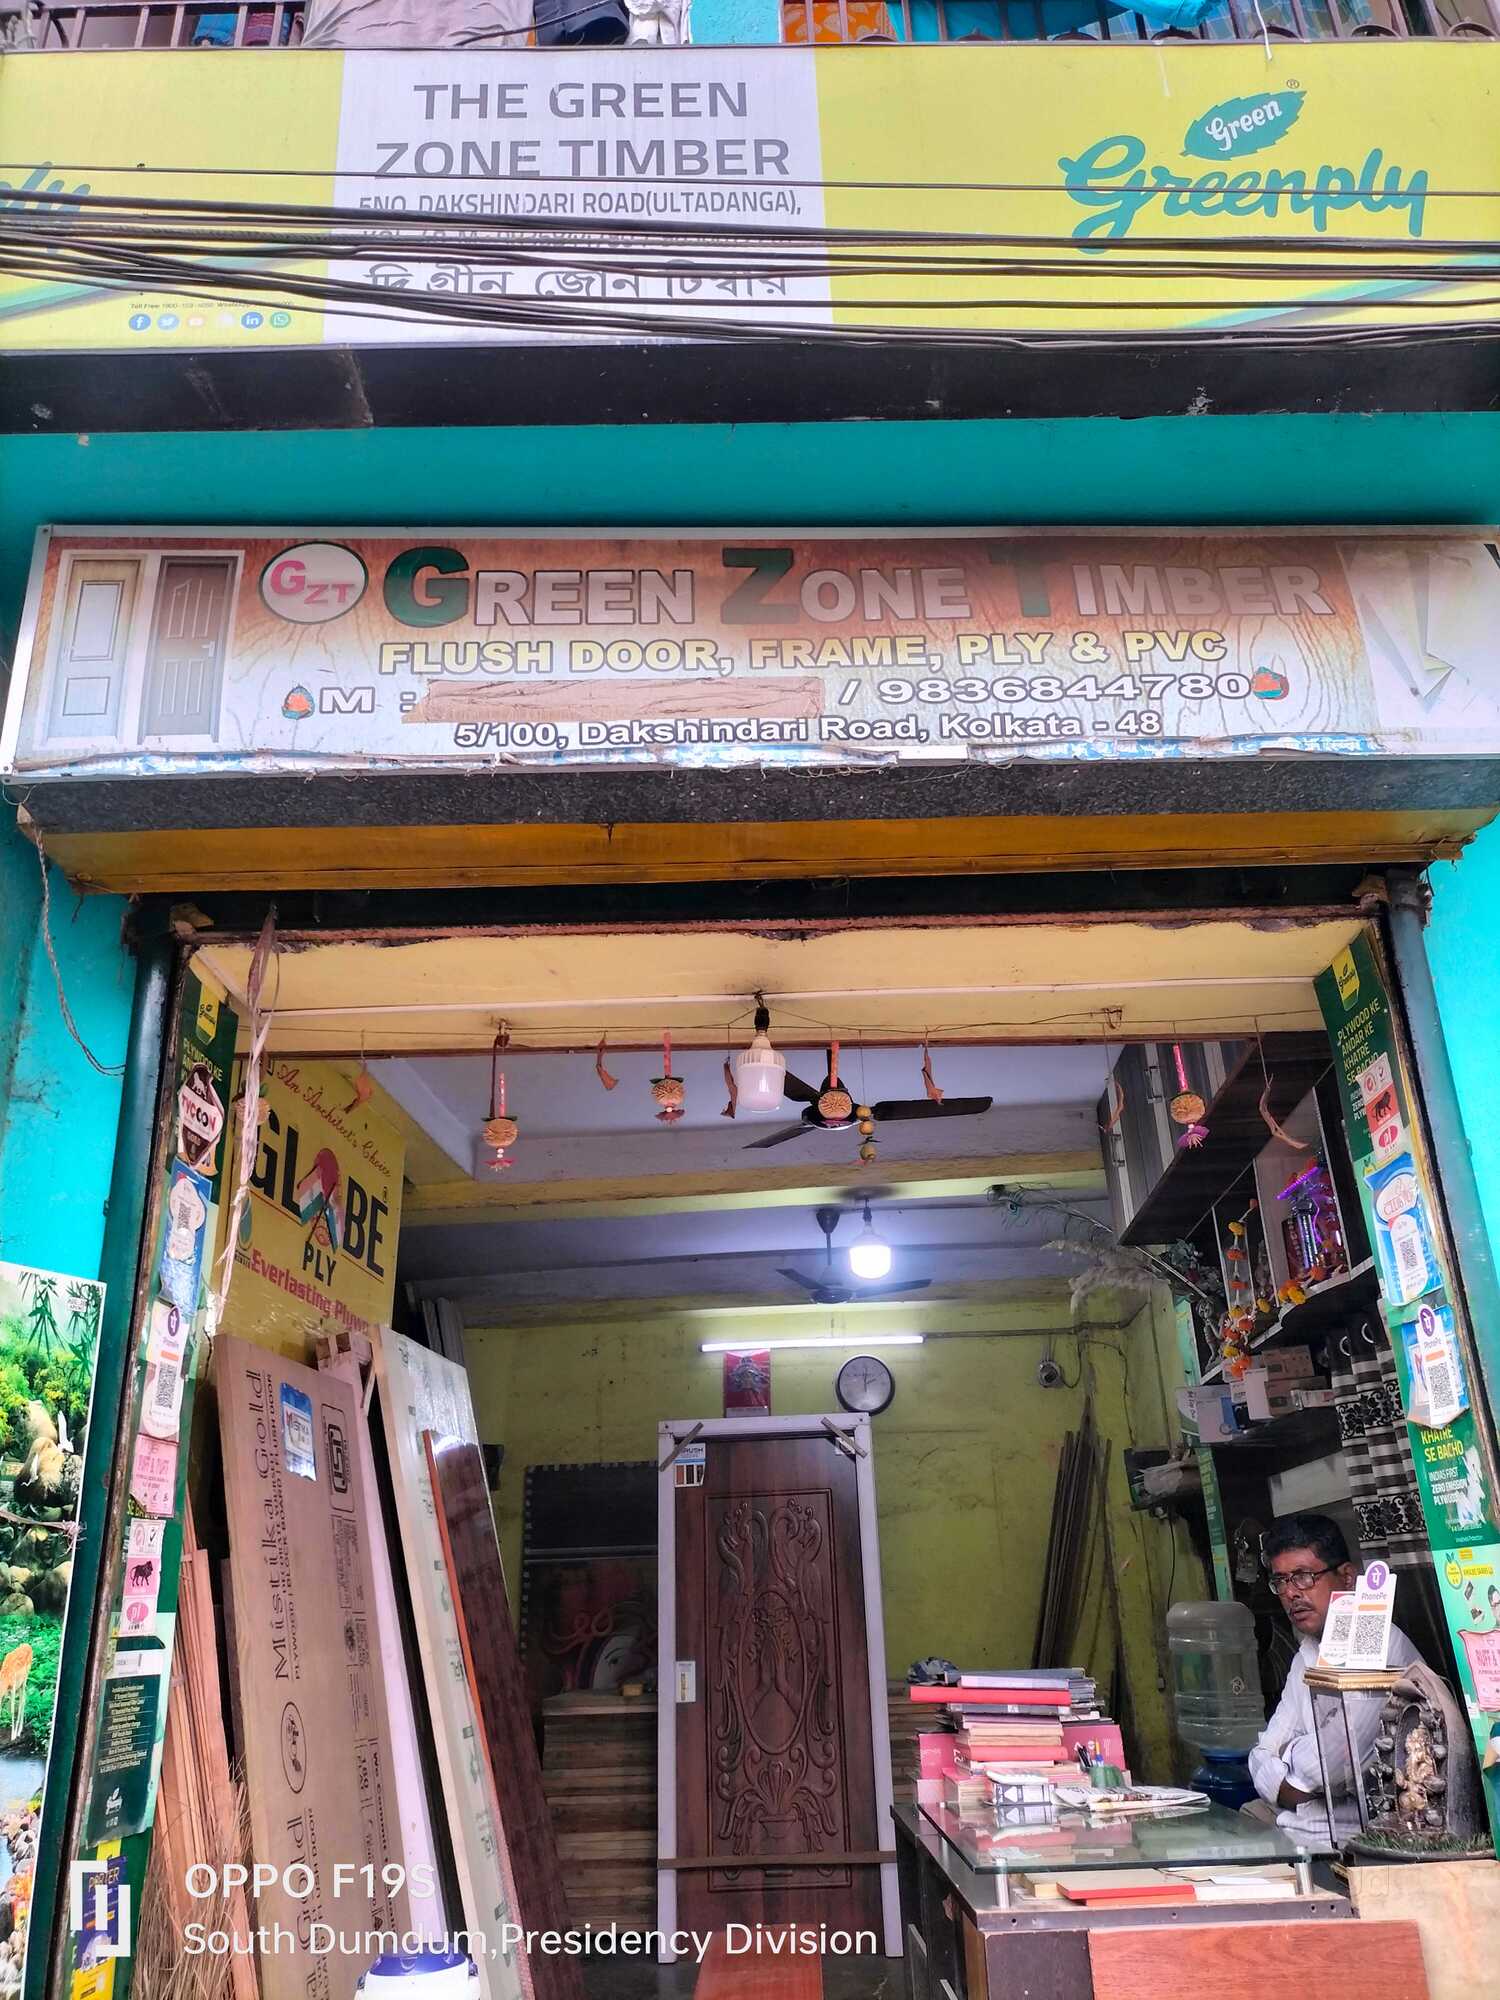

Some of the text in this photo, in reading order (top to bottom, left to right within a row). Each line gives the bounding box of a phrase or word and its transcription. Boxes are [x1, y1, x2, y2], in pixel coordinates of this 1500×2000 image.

[413, 82, 748, 120] THE GREEN
[1206, 96, 1284, 151] Green
[375, 137, 790, 178] ZONE TIMBER
[419, 192, 575, 215] DAKSHINDARI
[583, 190, 801, 216] ROAD(ULTADANGA),
[1057, 134, 1429, 253] Greenply
[269, 559, 356, 606] GZT
[382, 544, 1336, 628] GREEN ZONE TIMBER
[379, 630, 1227, 677] FLUSH DOOR, FRAME, PLY & PVC
[319, 686, 376, 714] M
[877, 672, 1250, 704] 9836844780
[454, 721, 568, 750] 5/100,
[578, 715, 809, 747] Dakshindari
[819, 715, 930, 743] Road,
[940, 712, 1082, 740] Kolkata
[1115, 711, 1162, 737] 48
[1338, 997, 1381, 1041] PLYWOOD KE
[1341, 1021, 1375, 1057] ANDAR KE
[1344, 1042, 1370, 1072] KHATRE
[250, 1247, 331, 1320] Everlasting
[302, 1239, 337, 1287] PLY
[1424, 1440, 1465, 1463] SE BACHO
[246, 1369, 290, 1681] Mistika Gold
